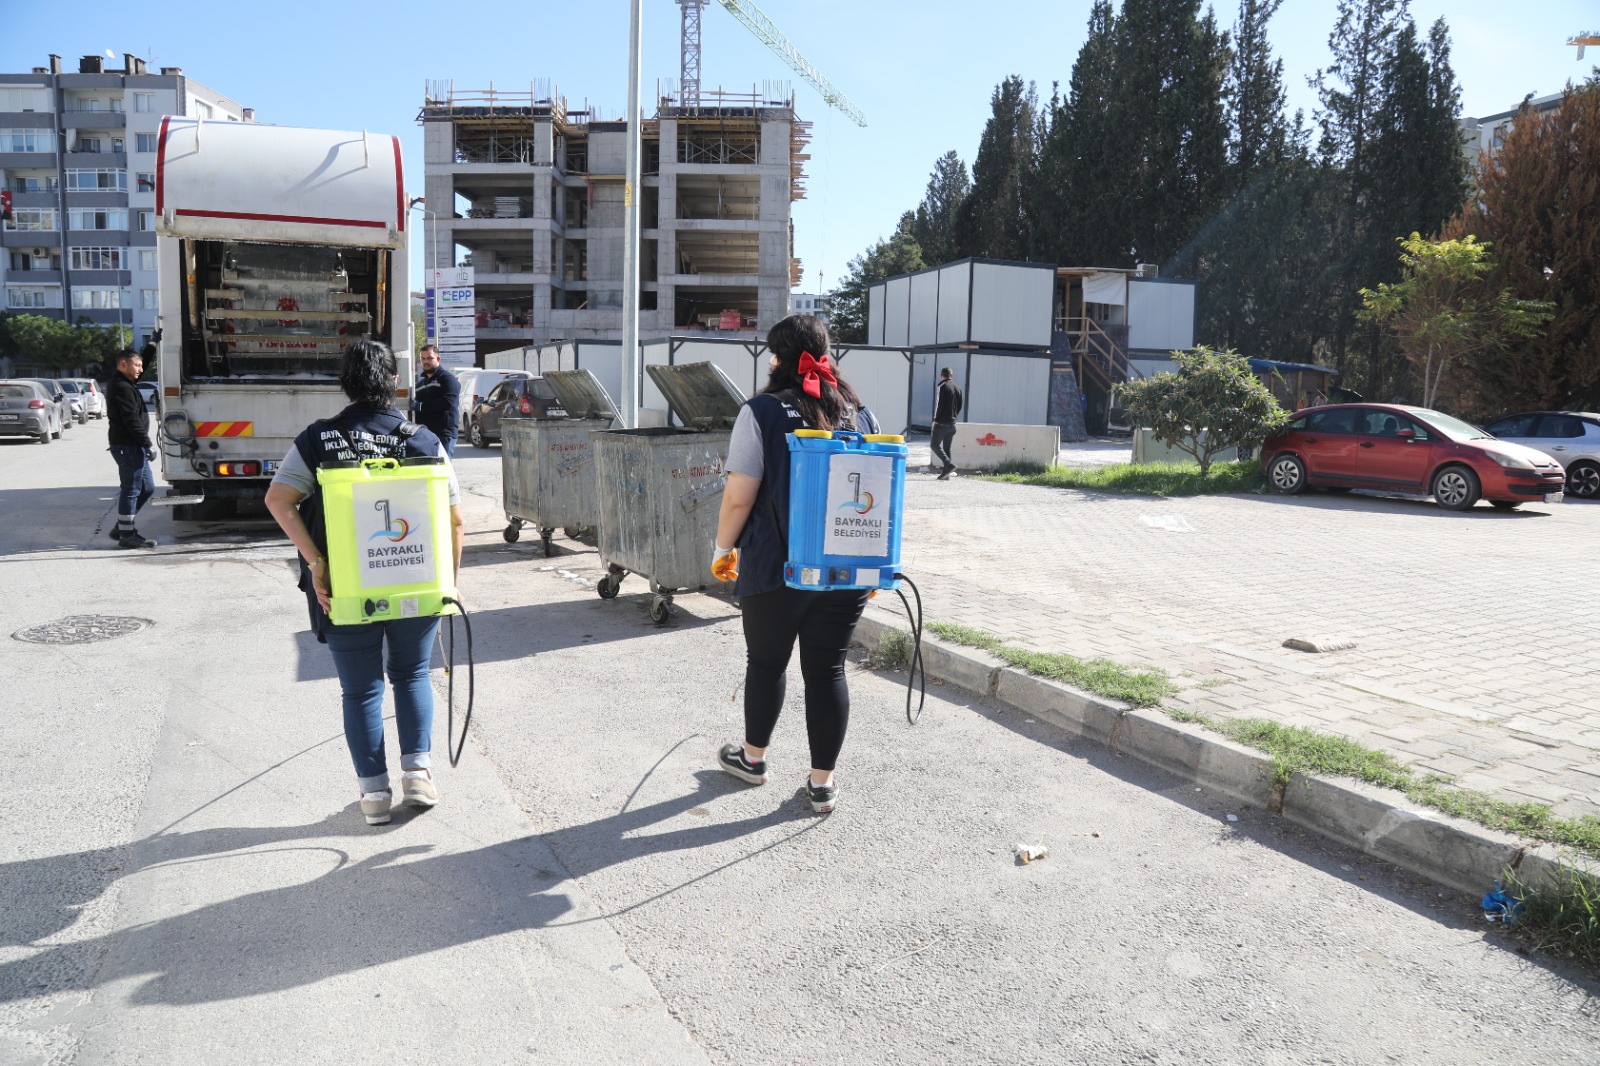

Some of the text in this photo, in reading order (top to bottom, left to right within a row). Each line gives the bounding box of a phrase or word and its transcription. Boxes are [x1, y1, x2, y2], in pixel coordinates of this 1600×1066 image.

[835, 517, 882, 528] BAYRAKLI
[833, 528, 882, 539] BELEDİYESİ
[367, 543, 424, 558] BAYRAKLI
[368, 554, 425, 569] BELEDİYESİ
